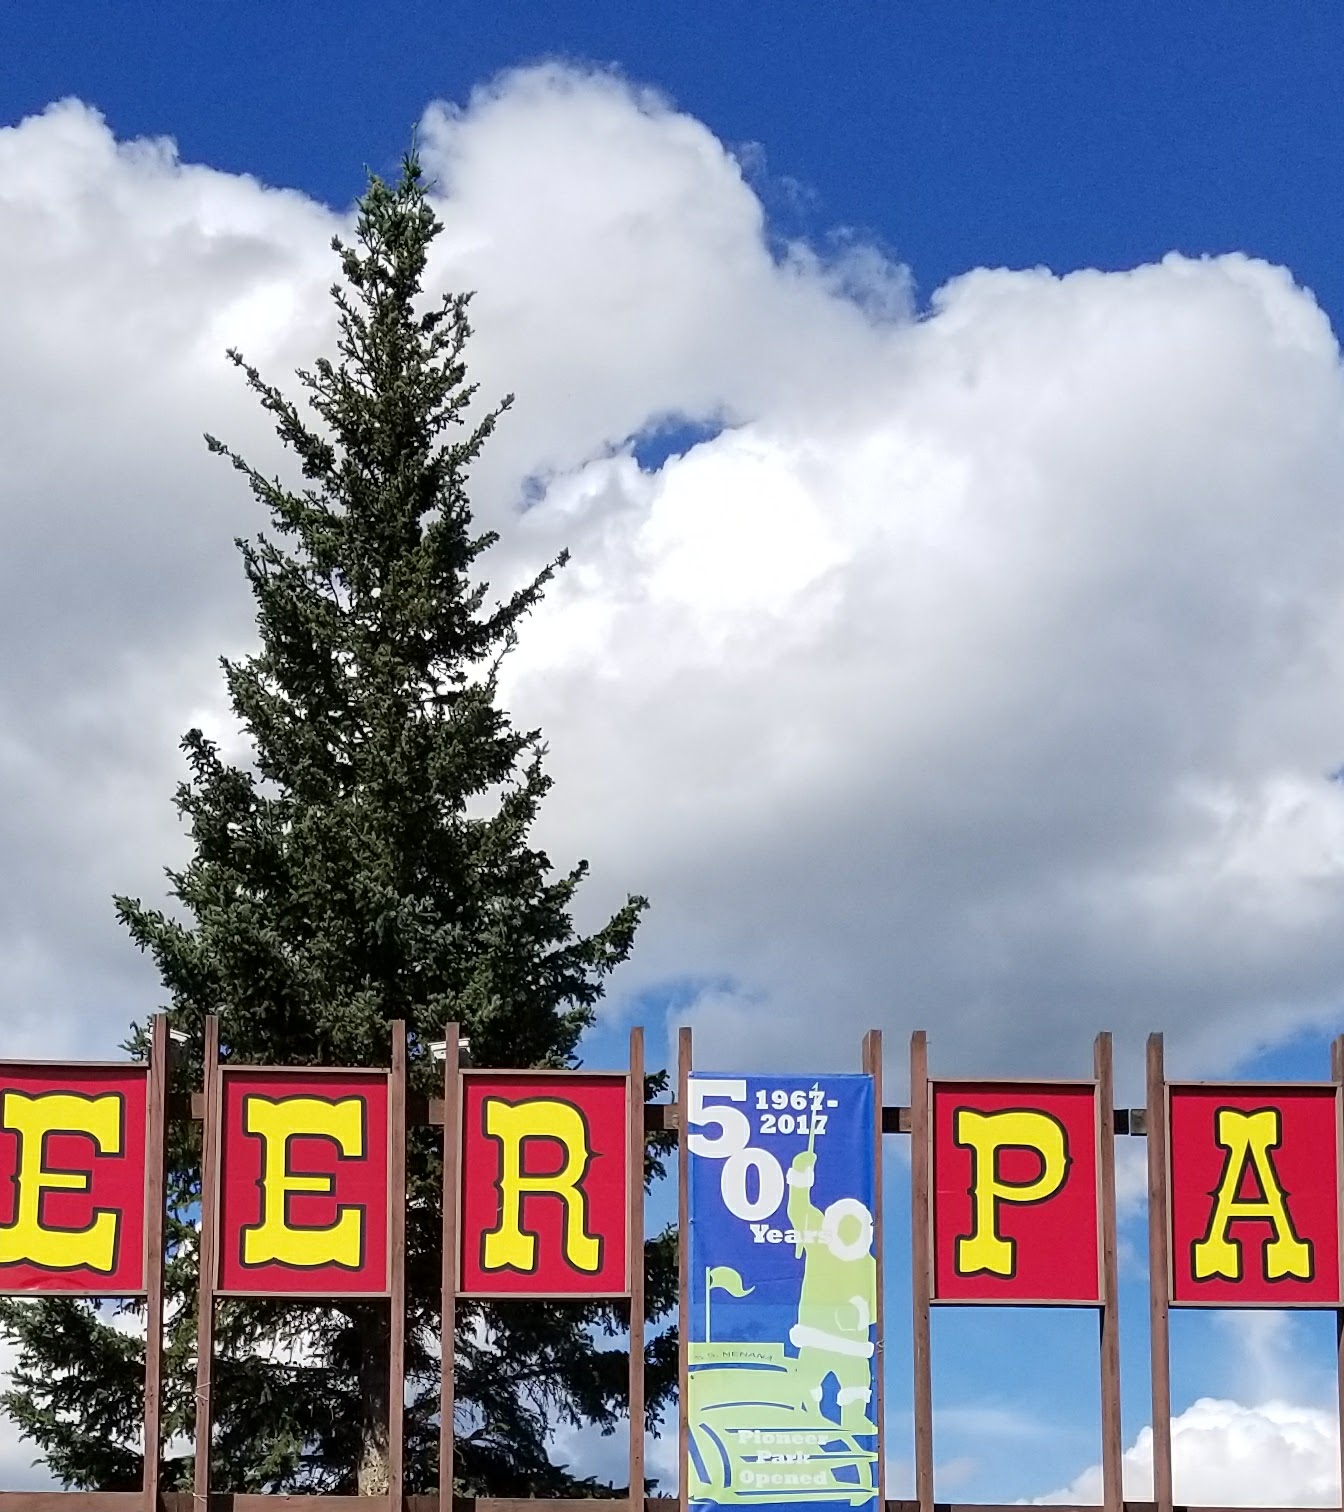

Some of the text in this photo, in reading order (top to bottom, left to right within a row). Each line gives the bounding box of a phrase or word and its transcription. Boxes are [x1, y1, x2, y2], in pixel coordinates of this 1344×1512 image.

[760, 1114, 828, 1135] 2017
[749, 1224, 833, 1244] Years
[737, 1430, 828, 1446] Pioneer
[756, 1450, 810, 1465] Park
[739, 1470, 827, 1487] Opened
